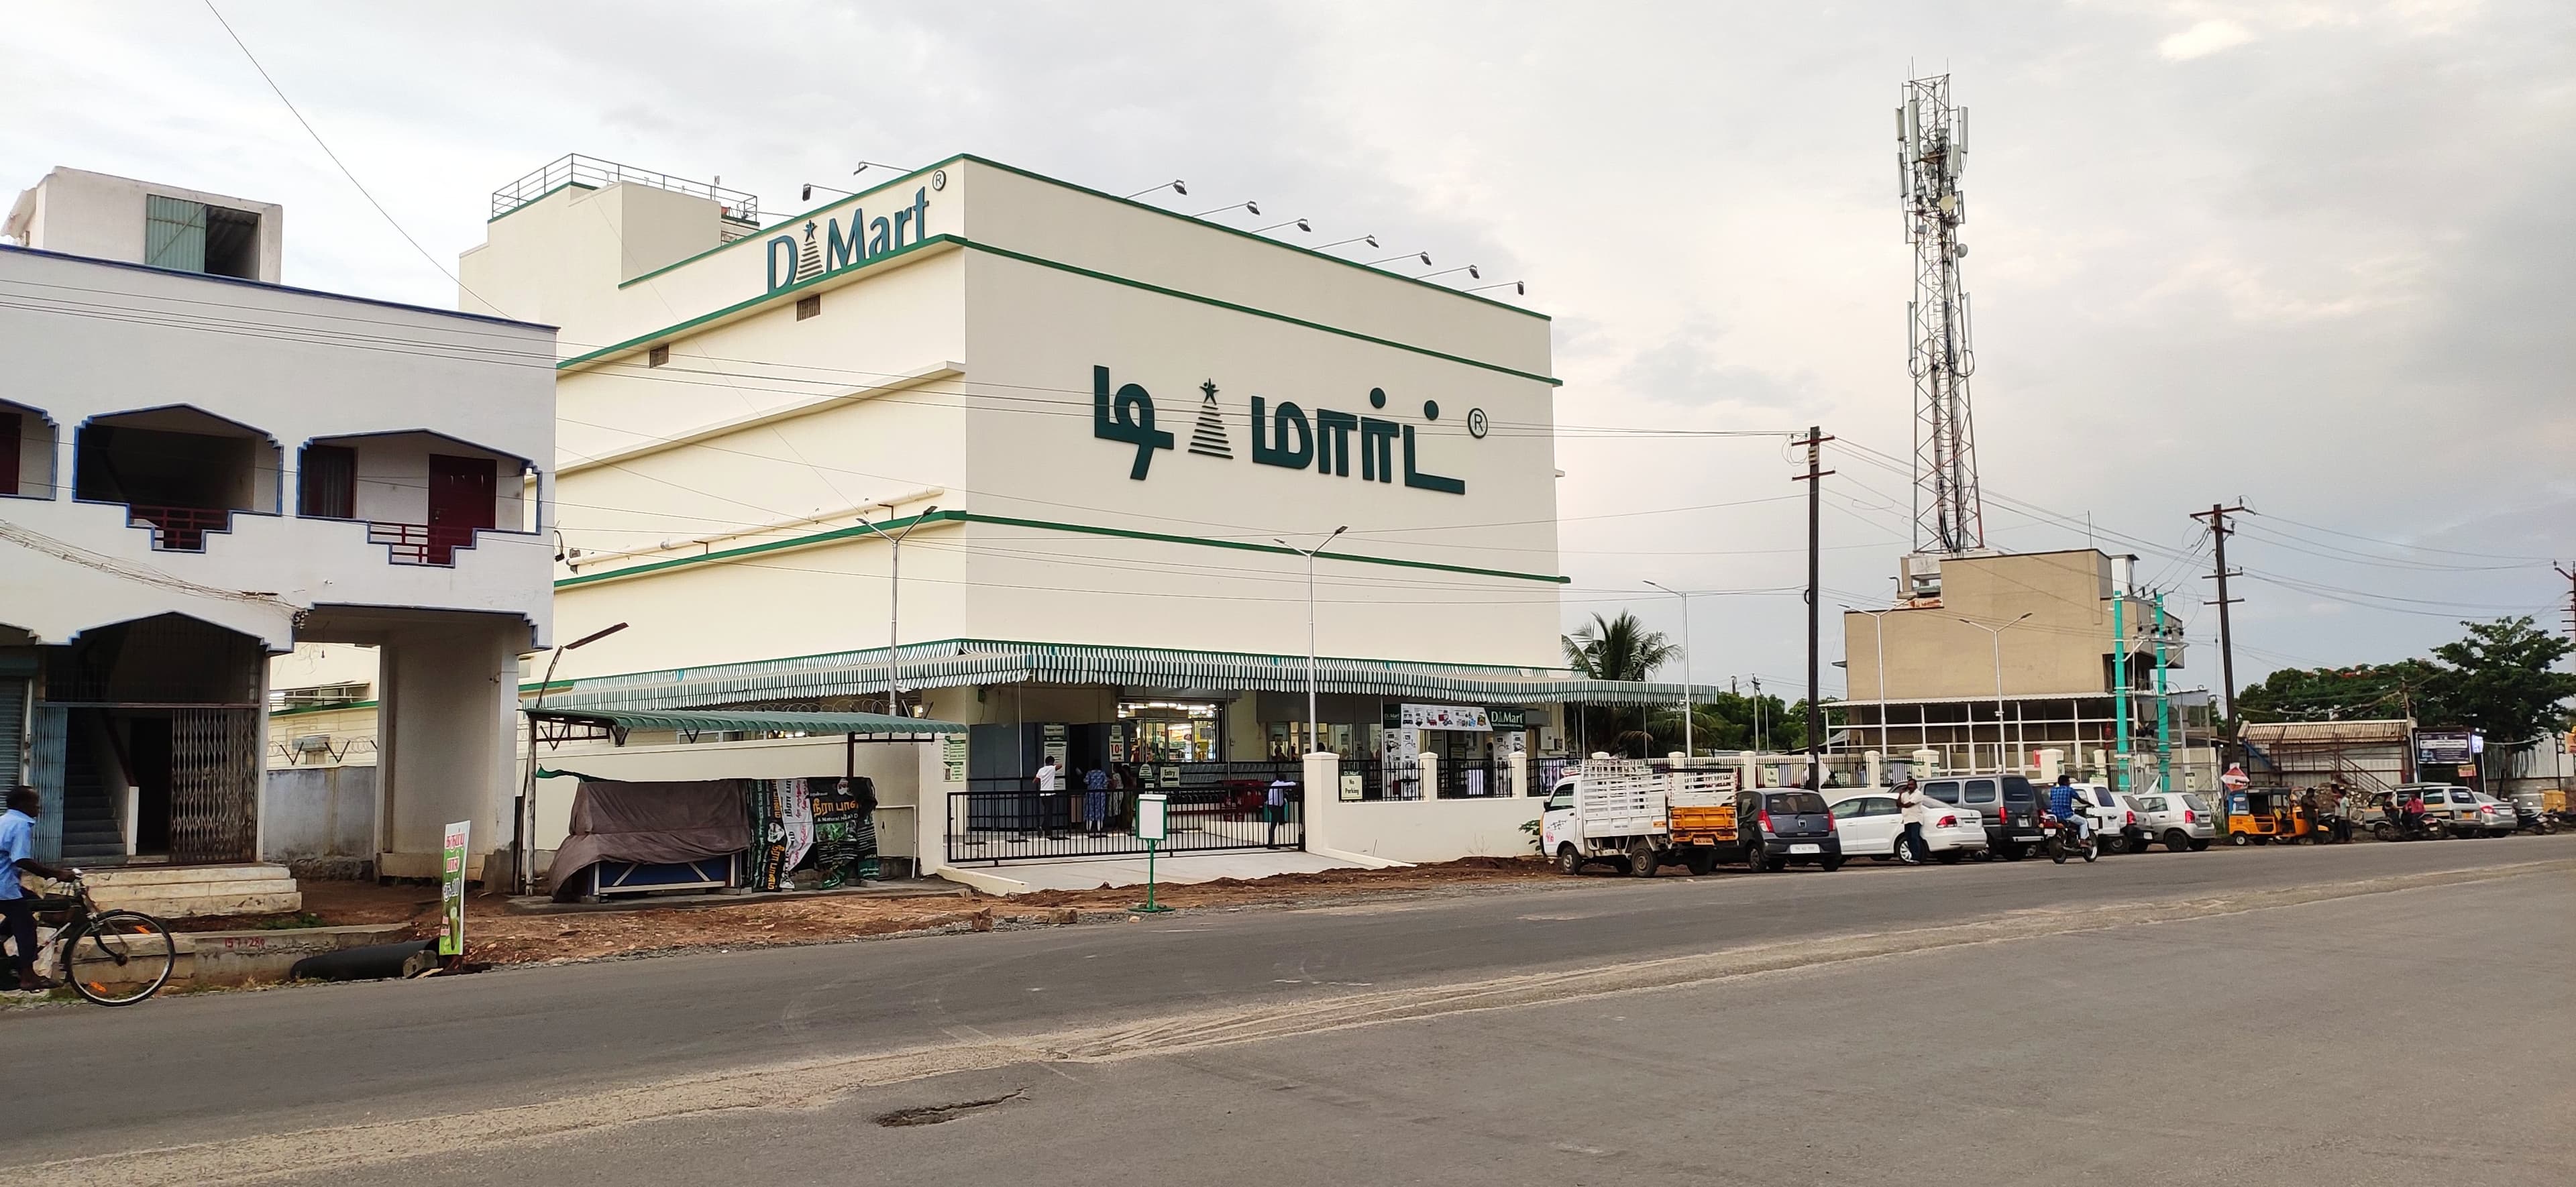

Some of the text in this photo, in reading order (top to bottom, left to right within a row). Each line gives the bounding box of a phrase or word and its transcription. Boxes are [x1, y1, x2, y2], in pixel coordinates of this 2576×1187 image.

[1093, 365, 1175, 481] டி
[1250, 387, 1466, 495] மார்ட்
[1345, 787, 1359, 796] Parking
[813, 797, 834, 817] நீரா
